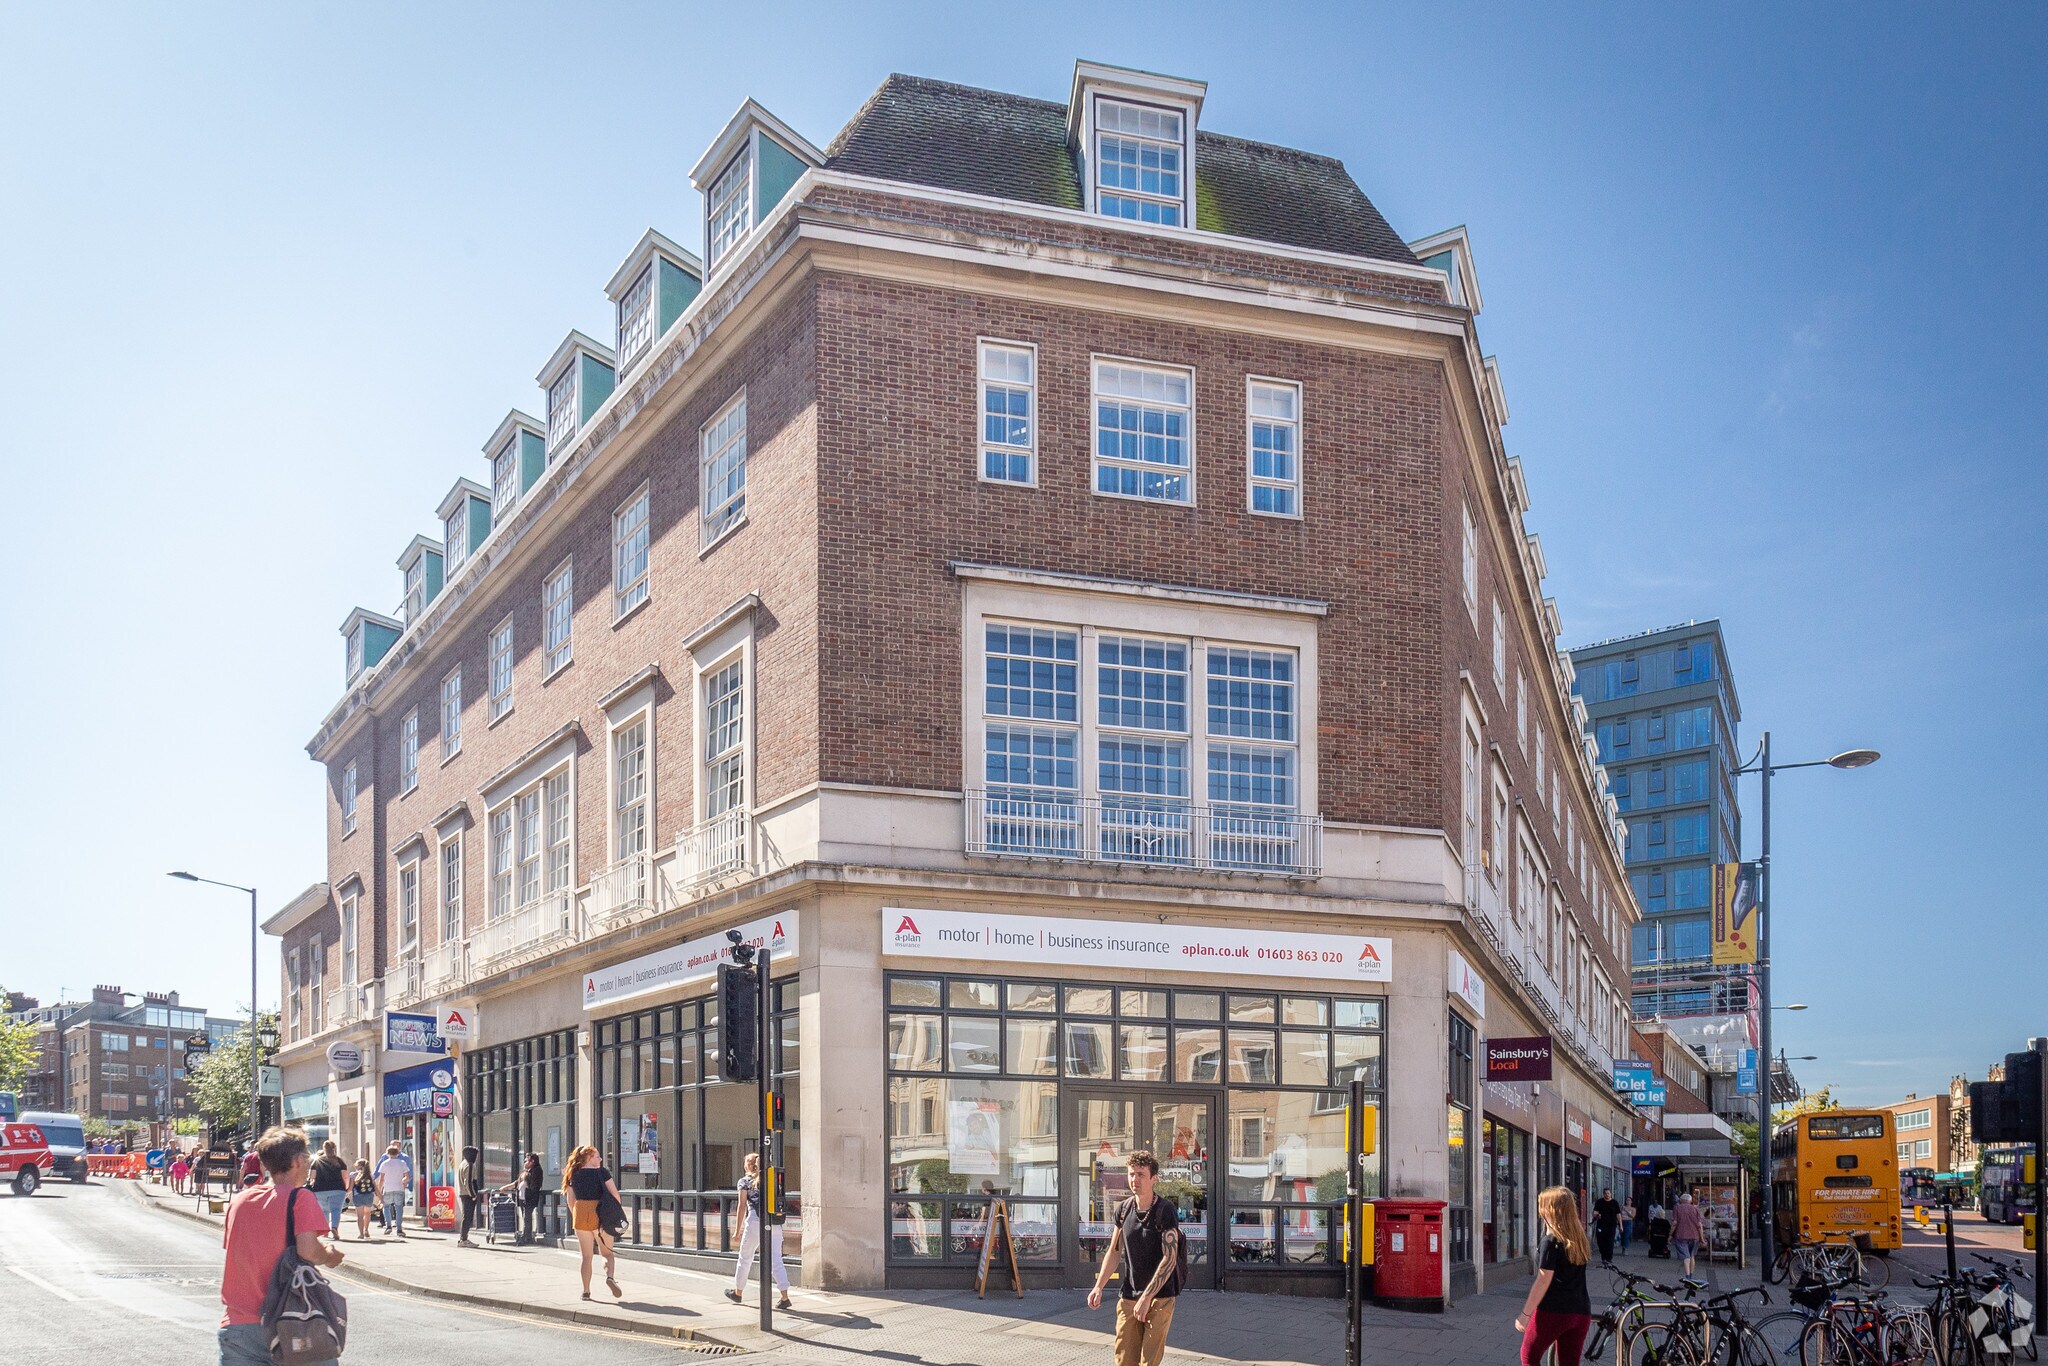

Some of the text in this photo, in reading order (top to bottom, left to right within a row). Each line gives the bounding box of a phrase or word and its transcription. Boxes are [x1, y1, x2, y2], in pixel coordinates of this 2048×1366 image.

[894, 933, 921, 943] a-plan
[938, 928, 1343, 963] motor home business insurance aplan.co.uk 01603 863 020
[1357, 960, 1381, 969] a-plan
[599, 979, 614, 993] motor
[617, 975, 632, 987] home
[635, 970, 657, 983] business
[657, 961, 683, 977] insurance
[687, 949, 718, 969] aplan.co.uk
[445, 1023, 467, 1032] a-plan
[389, 1030, 443, 1048] NEWS
[1489, 1048, 1549, 1060] Sainsbury's
[1489, 1059, 1519, 1070] Local
[261, 1069, 272, 1084] 7
[1615, 1078, 1647, 1090] to let
[1633, 1091, 1646, 1101] to
[1648, 1091, 1664, 1102] let
[763, 1135, 771, 1146] 5
